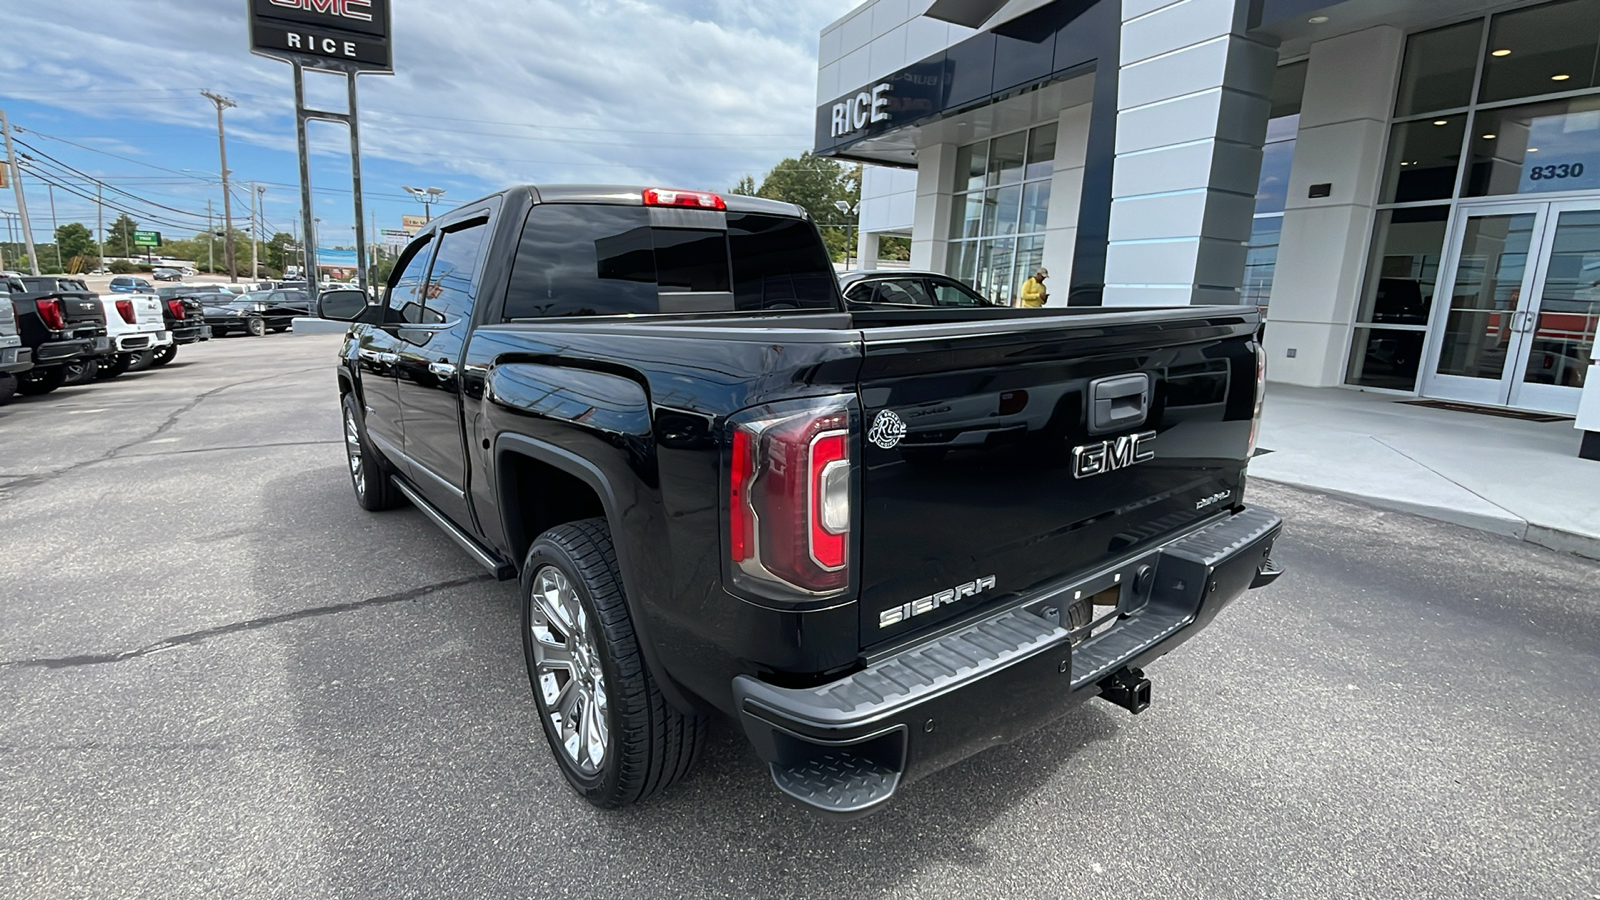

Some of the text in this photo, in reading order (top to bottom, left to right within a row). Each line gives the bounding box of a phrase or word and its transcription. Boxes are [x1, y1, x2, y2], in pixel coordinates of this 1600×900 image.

[287, 32, 356, 57] RICE
[831, 83, 889, 138] RICE
[1530, 162, 1583, 180] 8330
[868, 417, 907, 443] Rice
[1071, 430, 1157, 480] GMC
[879, 574, 997, 629] SIERRA
